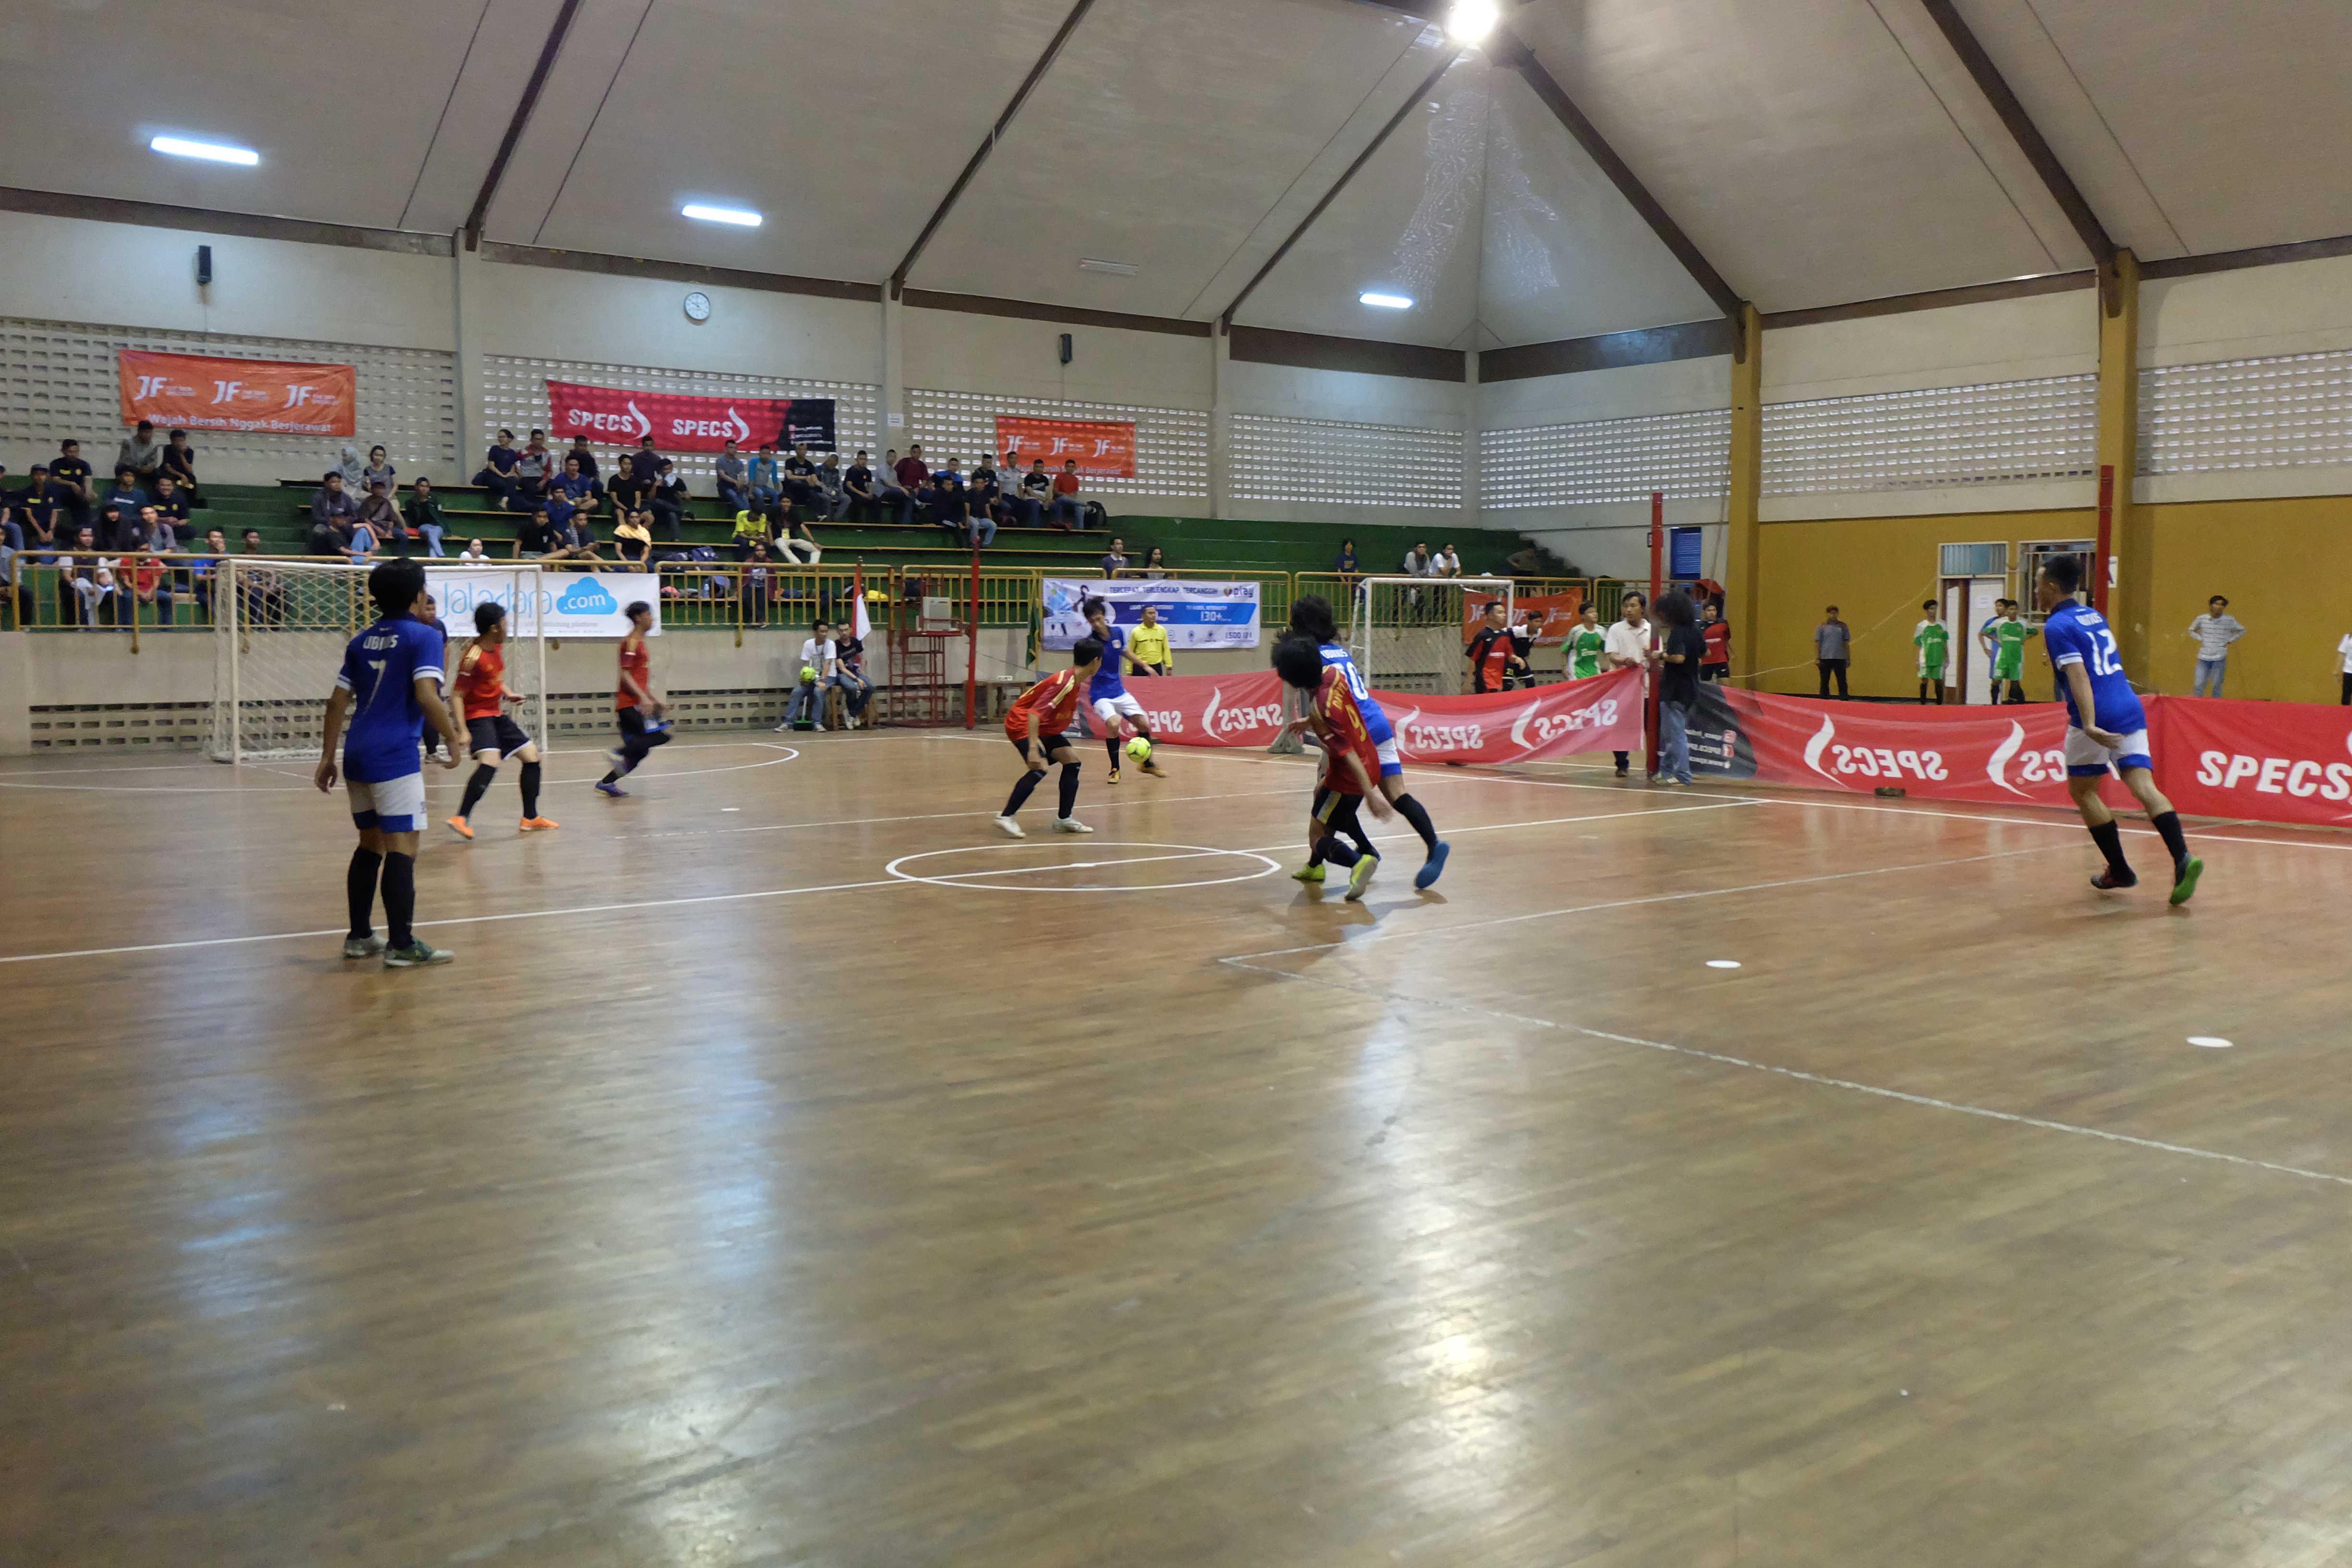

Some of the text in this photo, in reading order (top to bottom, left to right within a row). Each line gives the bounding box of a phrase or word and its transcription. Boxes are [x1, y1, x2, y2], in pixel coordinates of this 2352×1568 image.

[134, 376, 167, 400] JF
[210, 380, 242, 404] JF
[283, 385, 313, 408] JF
[147, 414, 187, 427] Wajah
[190, 415, 227, 426] Bersih
[230, 418, 267, 430] Nggak
[568, 408, 633, 433] SPECS
[673, 418, 733, 437] SPECS
[1004, 435, 1024, 454] JF
[1050, 437, 1069, 455] JF
[1093, 439, 1111, 457] JF
[564, 593, 605, 610] .com
[2085, 629, 2123, 675] 12
[367, 660, 386, 715] 7
[2196, 750, 2352, 800] SPECS
